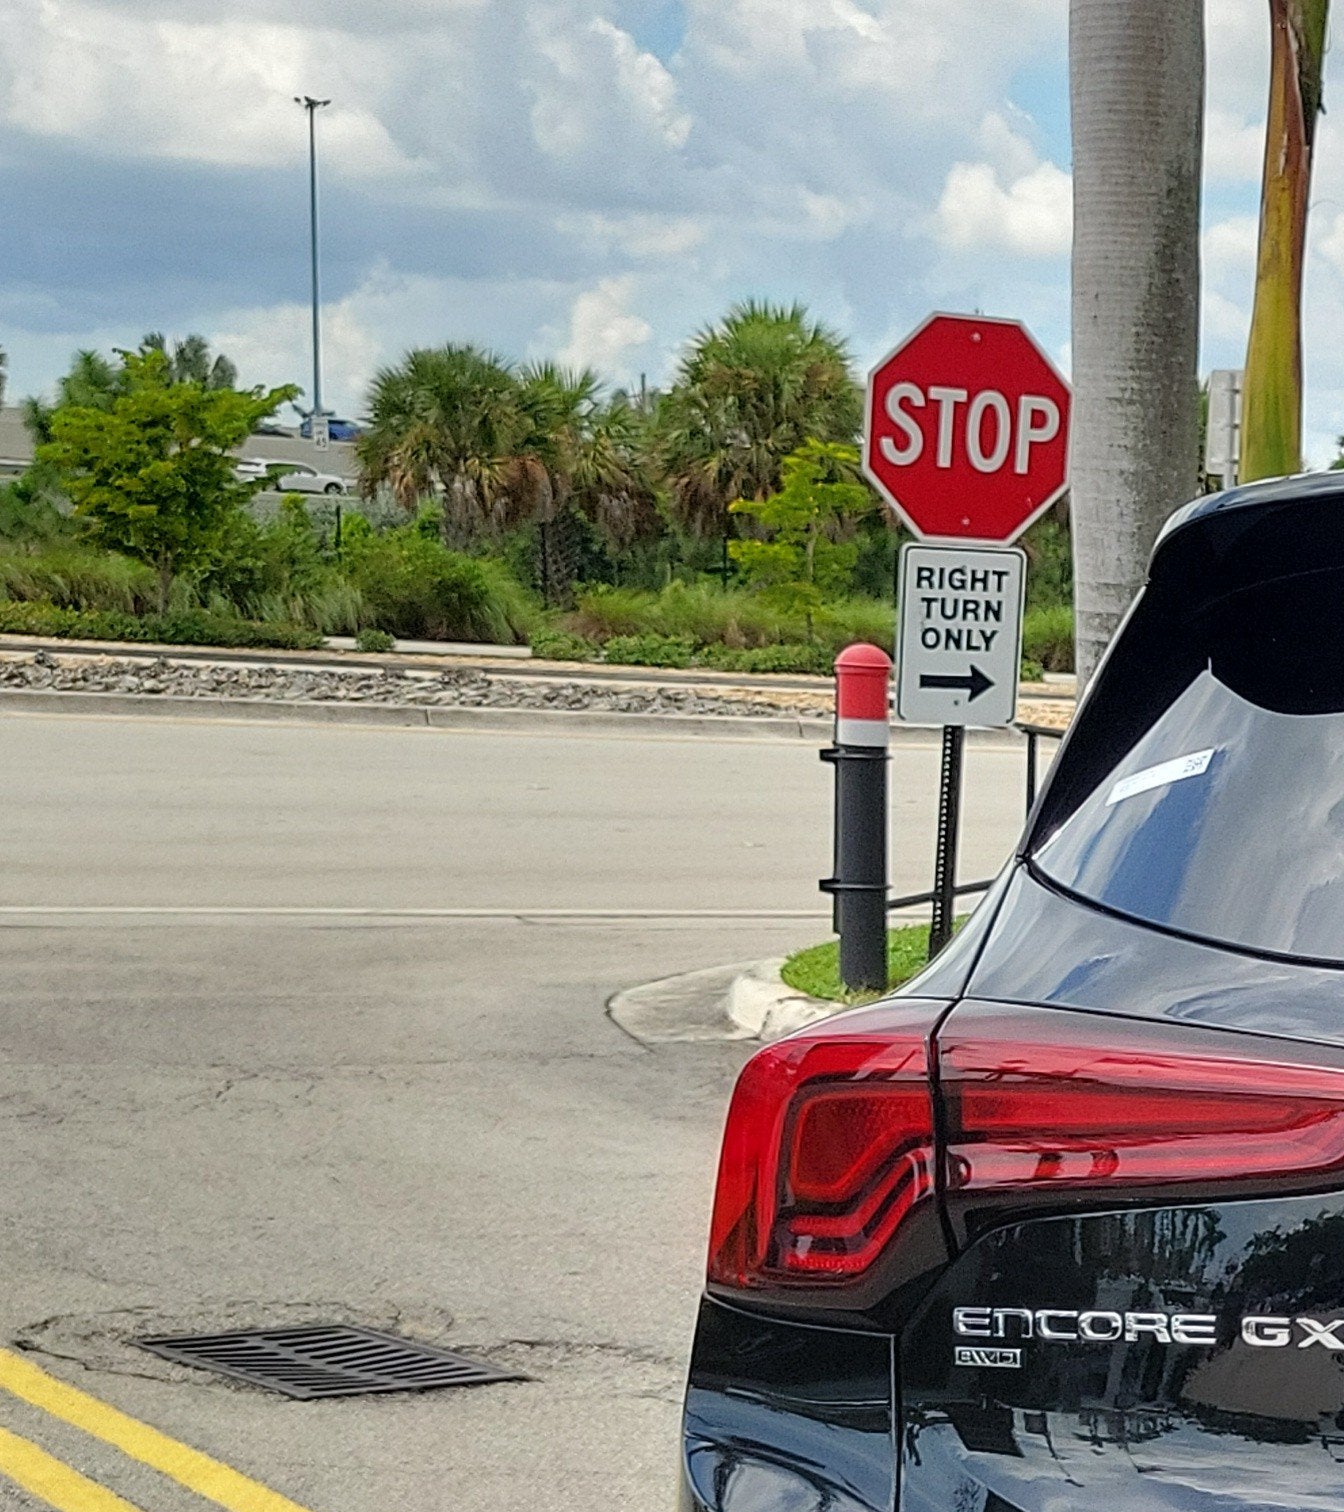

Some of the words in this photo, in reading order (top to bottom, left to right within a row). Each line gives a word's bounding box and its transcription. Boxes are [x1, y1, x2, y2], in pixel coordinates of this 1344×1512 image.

[879, 381, 1060, 475] STOP
[916, 566, 1010, 593] RIGHT
[920, 597, 1003, 623] TURN
[921, 627, 998, 652] ONLY
[952, 1306, 1218, 1345] ENCORE
